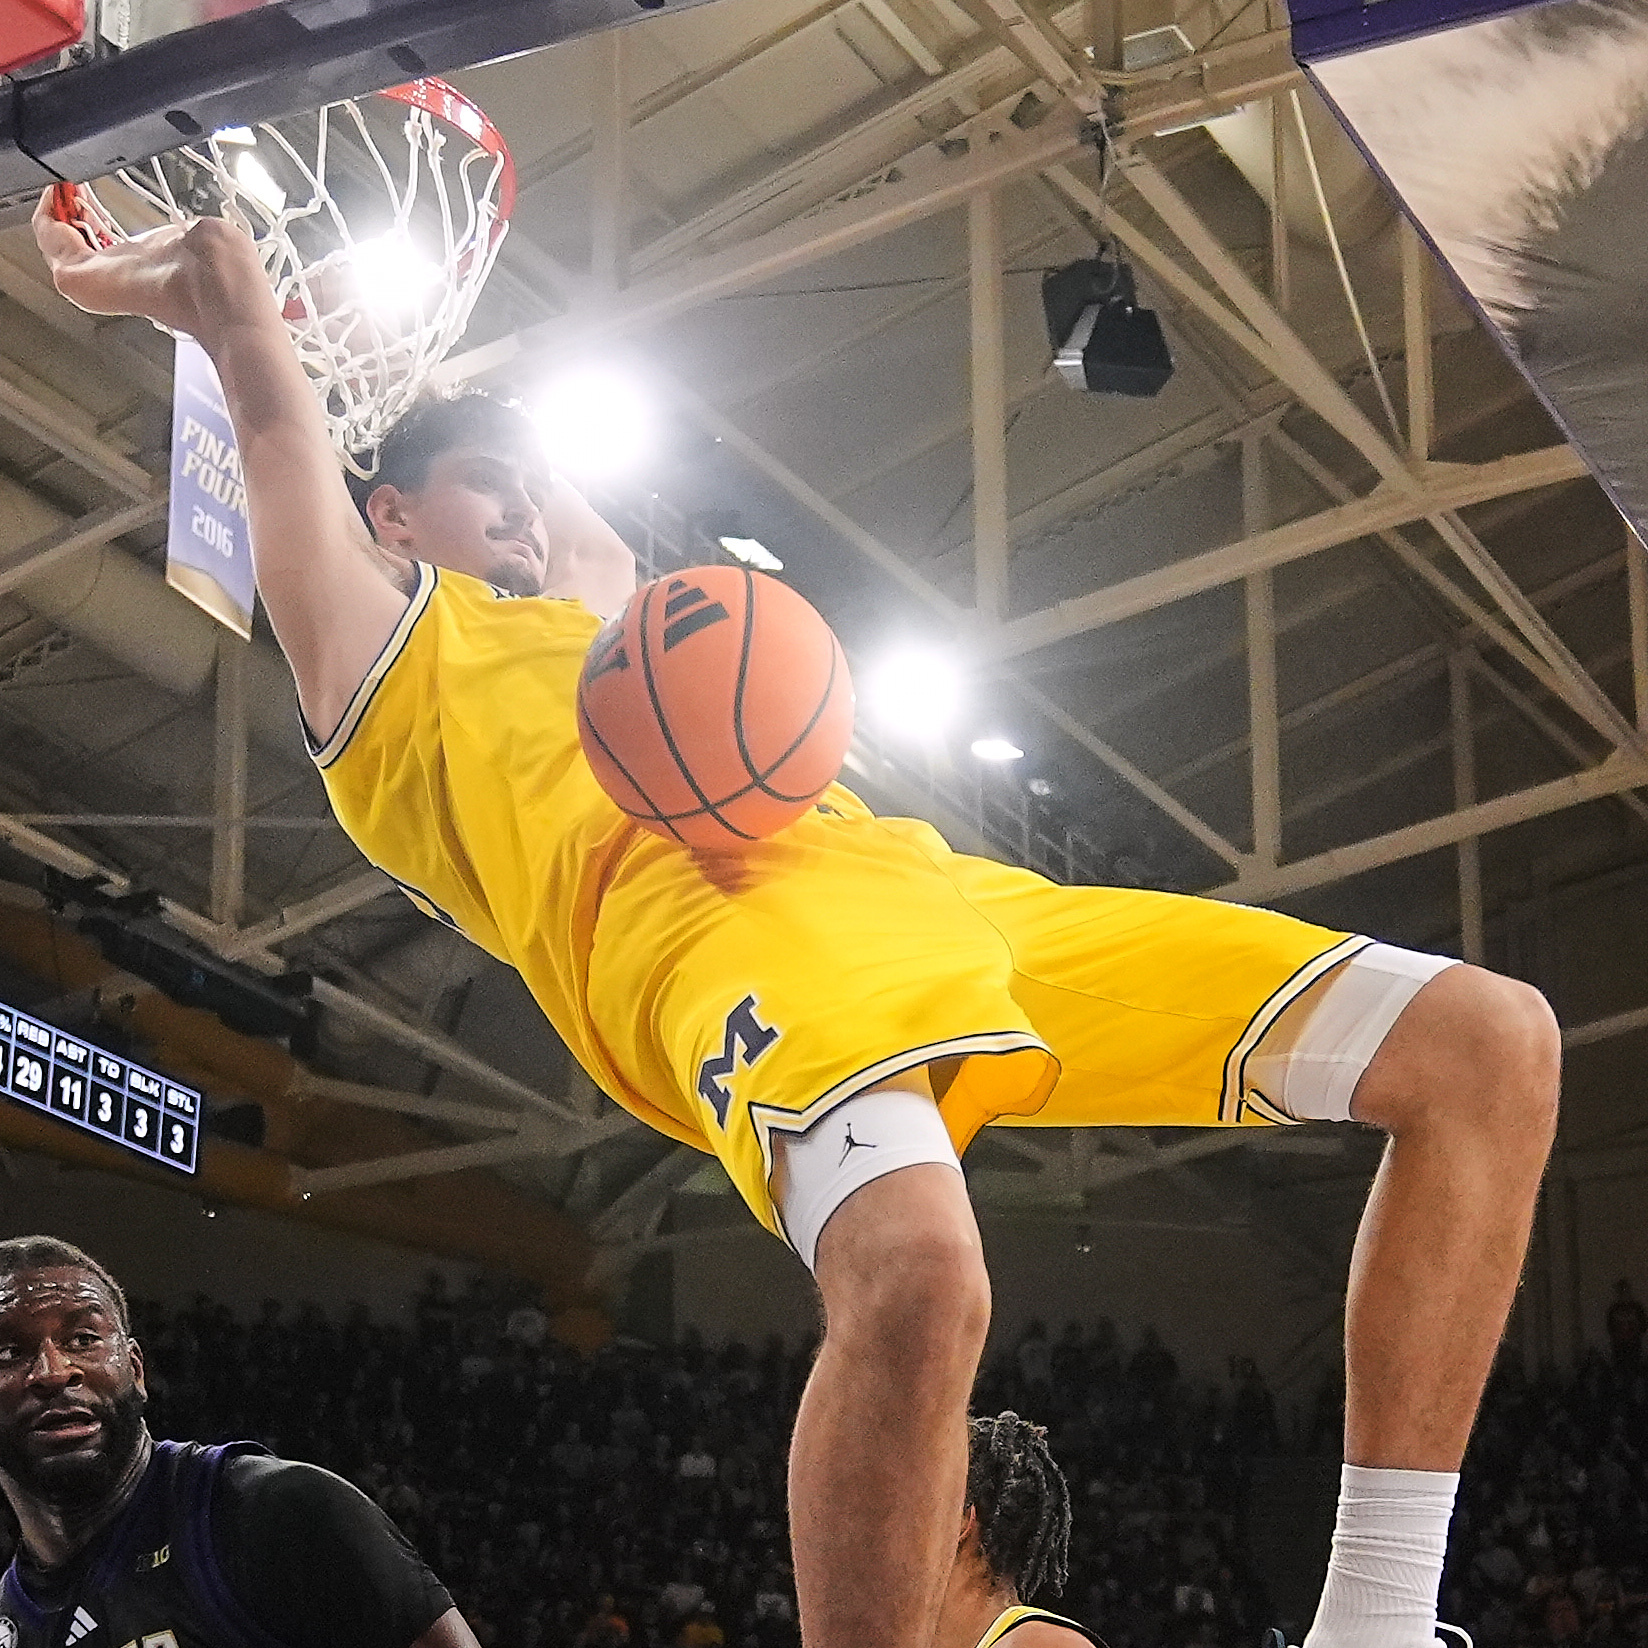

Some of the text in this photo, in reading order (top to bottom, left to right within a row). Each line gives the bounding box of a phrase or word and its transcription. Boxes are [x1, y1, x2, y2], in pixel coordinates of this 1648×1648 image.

[180, 415, 244, 487] FINA
[191, 504, 234, 559] 2016
[55, 1039, 88, 1064] AST
[98, 1056, 120, 1079] TO
[15, 1056, 43, 1092] 29
[59, 1076, 82, 1110] 11
[97, 1091, 112, 1123] 3
[132, 1108, 148, 1139] 3
[170, 1124, 185, 1155] 3
